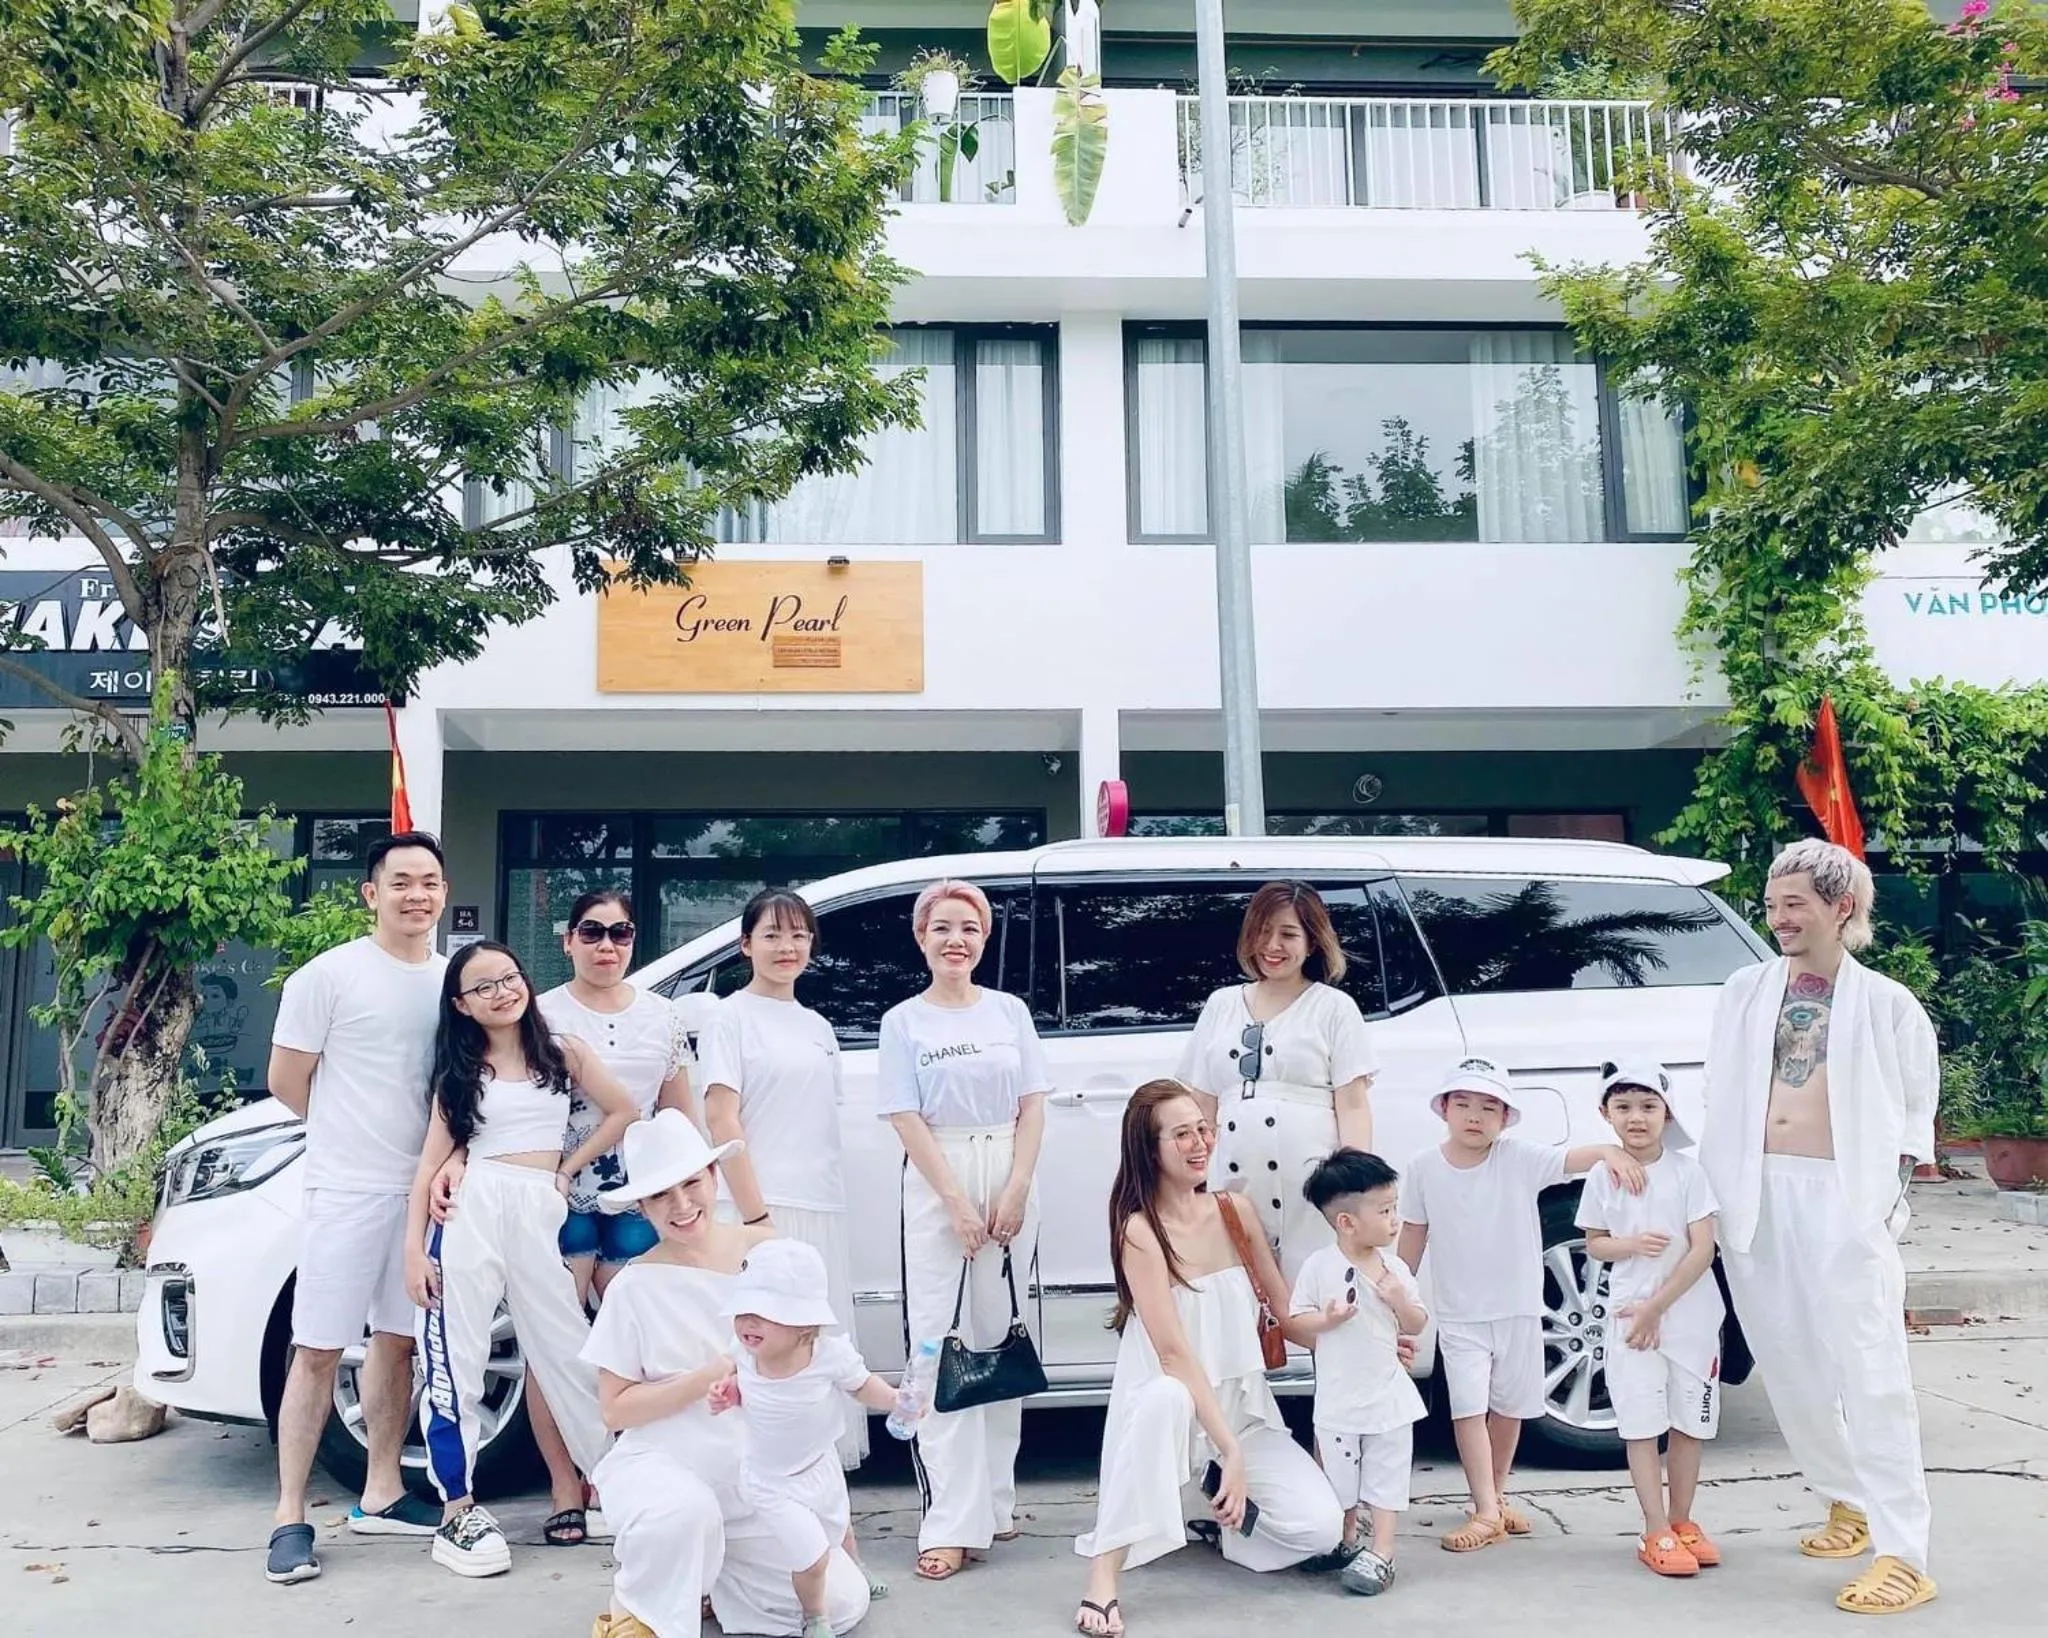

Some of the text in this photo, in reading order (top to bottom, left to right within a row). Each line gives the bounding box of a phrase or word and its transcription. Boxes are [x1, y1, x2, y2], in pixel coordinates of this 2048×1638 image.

[1904, 587, 1970, 615] VĂN
[676, 594, 848, 642] Green Pearl
[920, 1043, 982, 1067] CHANEL
